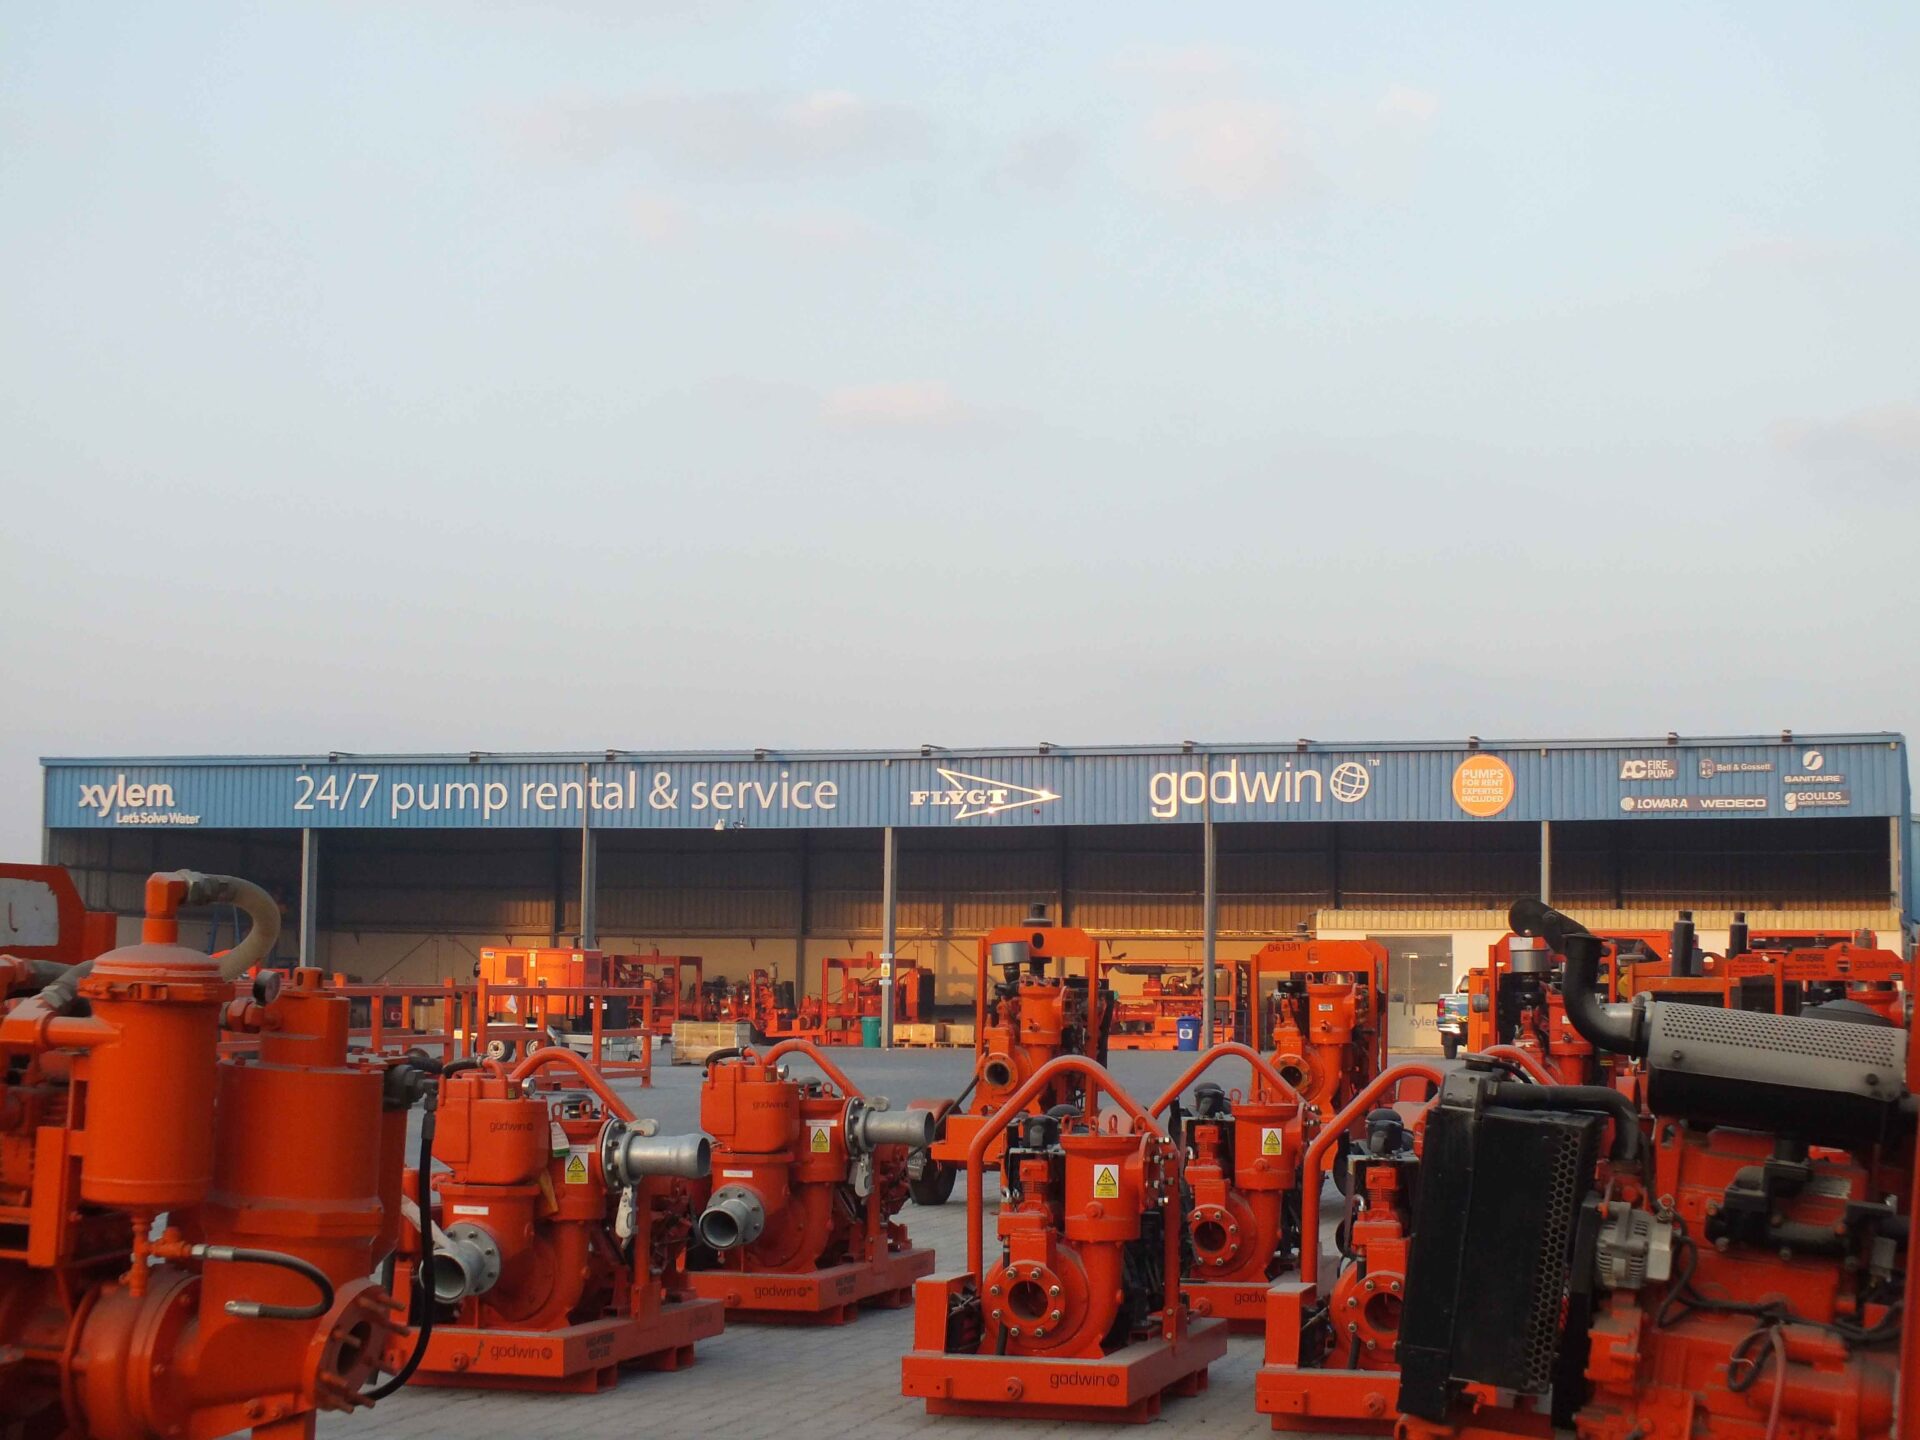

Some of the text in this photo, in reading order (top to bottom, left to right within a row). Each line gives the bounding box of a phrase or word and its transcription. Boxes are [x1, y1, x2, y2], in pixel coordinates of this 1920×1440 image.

[1620, 760, 1647, 779] AC
[1647, 760, 1668, 770] FIRE
[1717, 763, 1732, 772] Bell
[1462, 769, 1504, 779] PUMPS
[1647, 769, 1674, 779] PUMP
[1150, 759, 1322, 818] godwin
[79, 774, 175, 817] xylem
[294, 771, 838, 820] 24/7 pump rental & service
[910, 789, 1007, 806] FLYGT
[1797, 792, 1842, 801] GOULDS
[1637, 799, 1688, 809] LOWARA
[1700, 799, 1766, 808] WEDECO
[140, 812, 168, 824] Solve
[168, 813, 200, 824] Water
[490, 1120, 527, 1133] godwin
[754, 1284, 795, 1298] godwin
[491, 1344, 541, 1359] godwin
[1050, 1370, 1105, 1389] godwin
